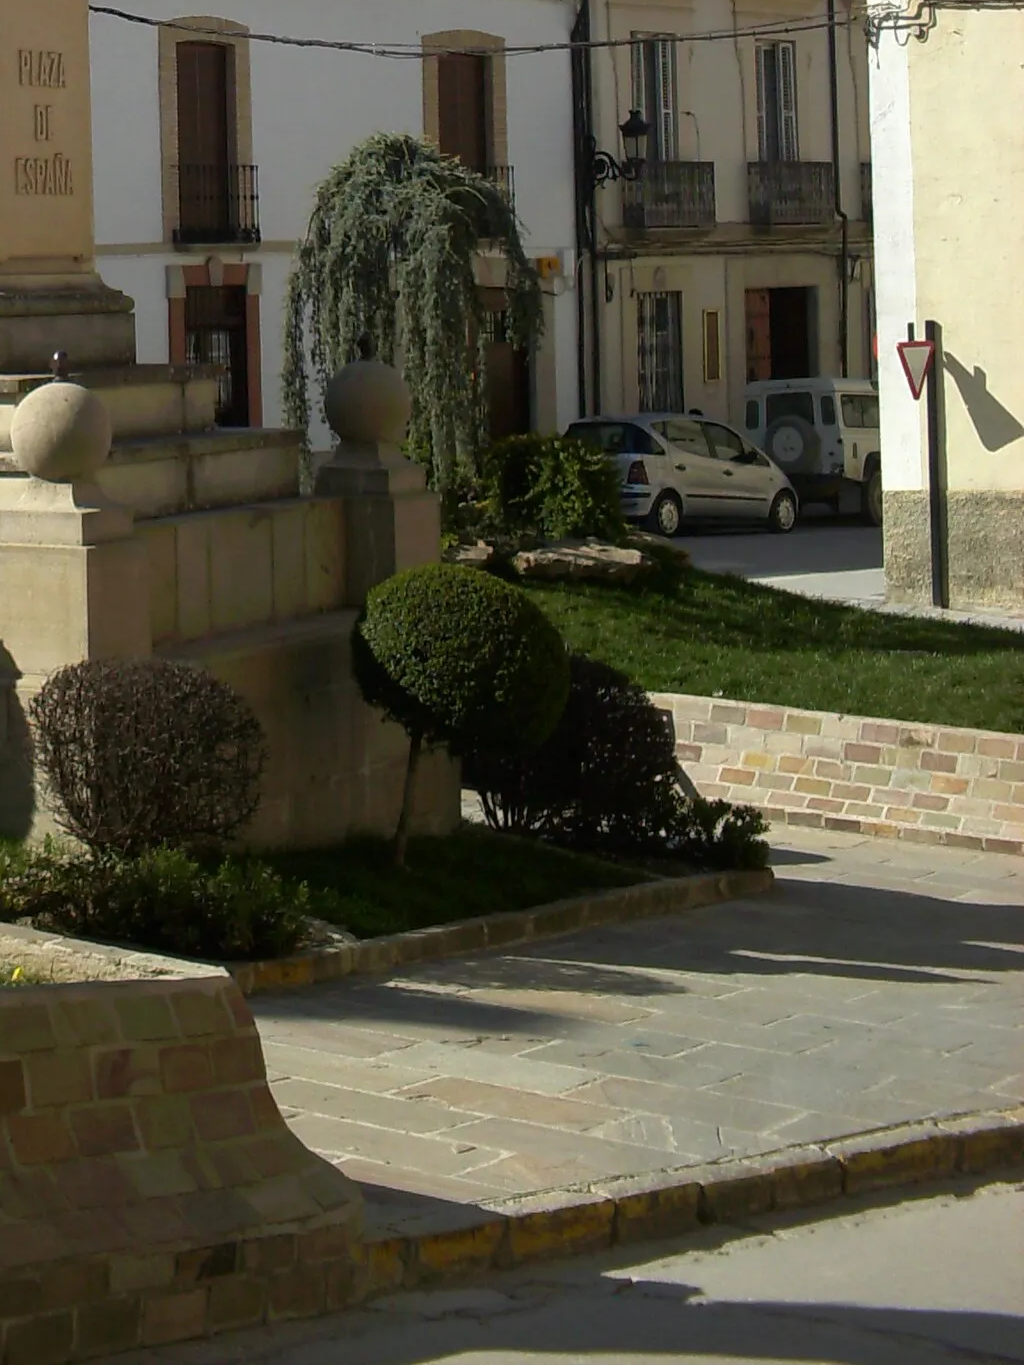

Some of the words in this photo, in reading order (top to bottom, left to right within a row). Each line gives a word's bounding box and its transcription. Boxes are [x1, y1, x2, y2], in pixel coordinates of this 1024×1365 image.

[18, 49, 67, 89] PLAZA
[33, 104, 53, 142] DE
[15, 152, 74, 196] ESPAÑA
